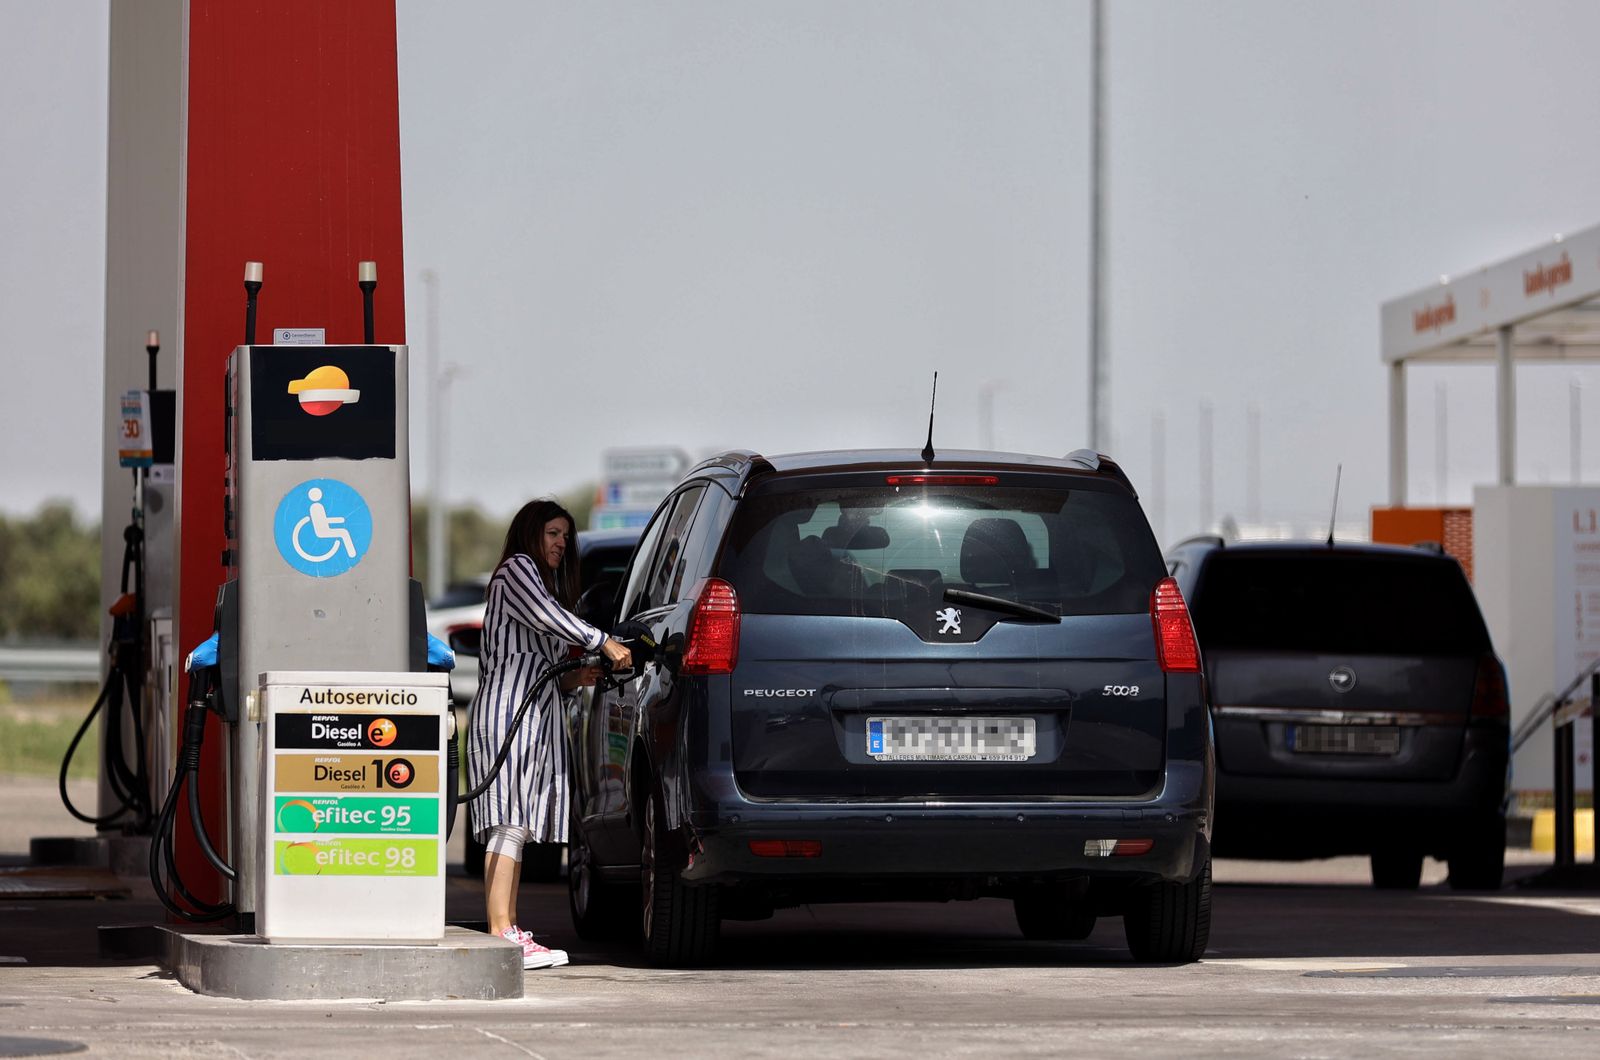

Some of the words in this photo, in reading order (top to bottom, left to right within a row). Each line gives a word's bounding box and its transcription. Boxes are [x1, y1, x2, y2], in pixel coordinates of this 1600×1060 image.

[299, 688, 418, 706] Autoservicio
[743, 688, 817, 697] PEUGEOT
[1102, 685, 1140, 696] 5008
[311, 723, 362, 740] Diesel
[873, 740, 880, 748] E
[314, 765, 366, 781] Diesel
[312, 806, 376, 824] efitec
[380, 805, 411, 826] 95
[315, 848, 380, 866] efitec
[384, 847, 416, 869] 98
